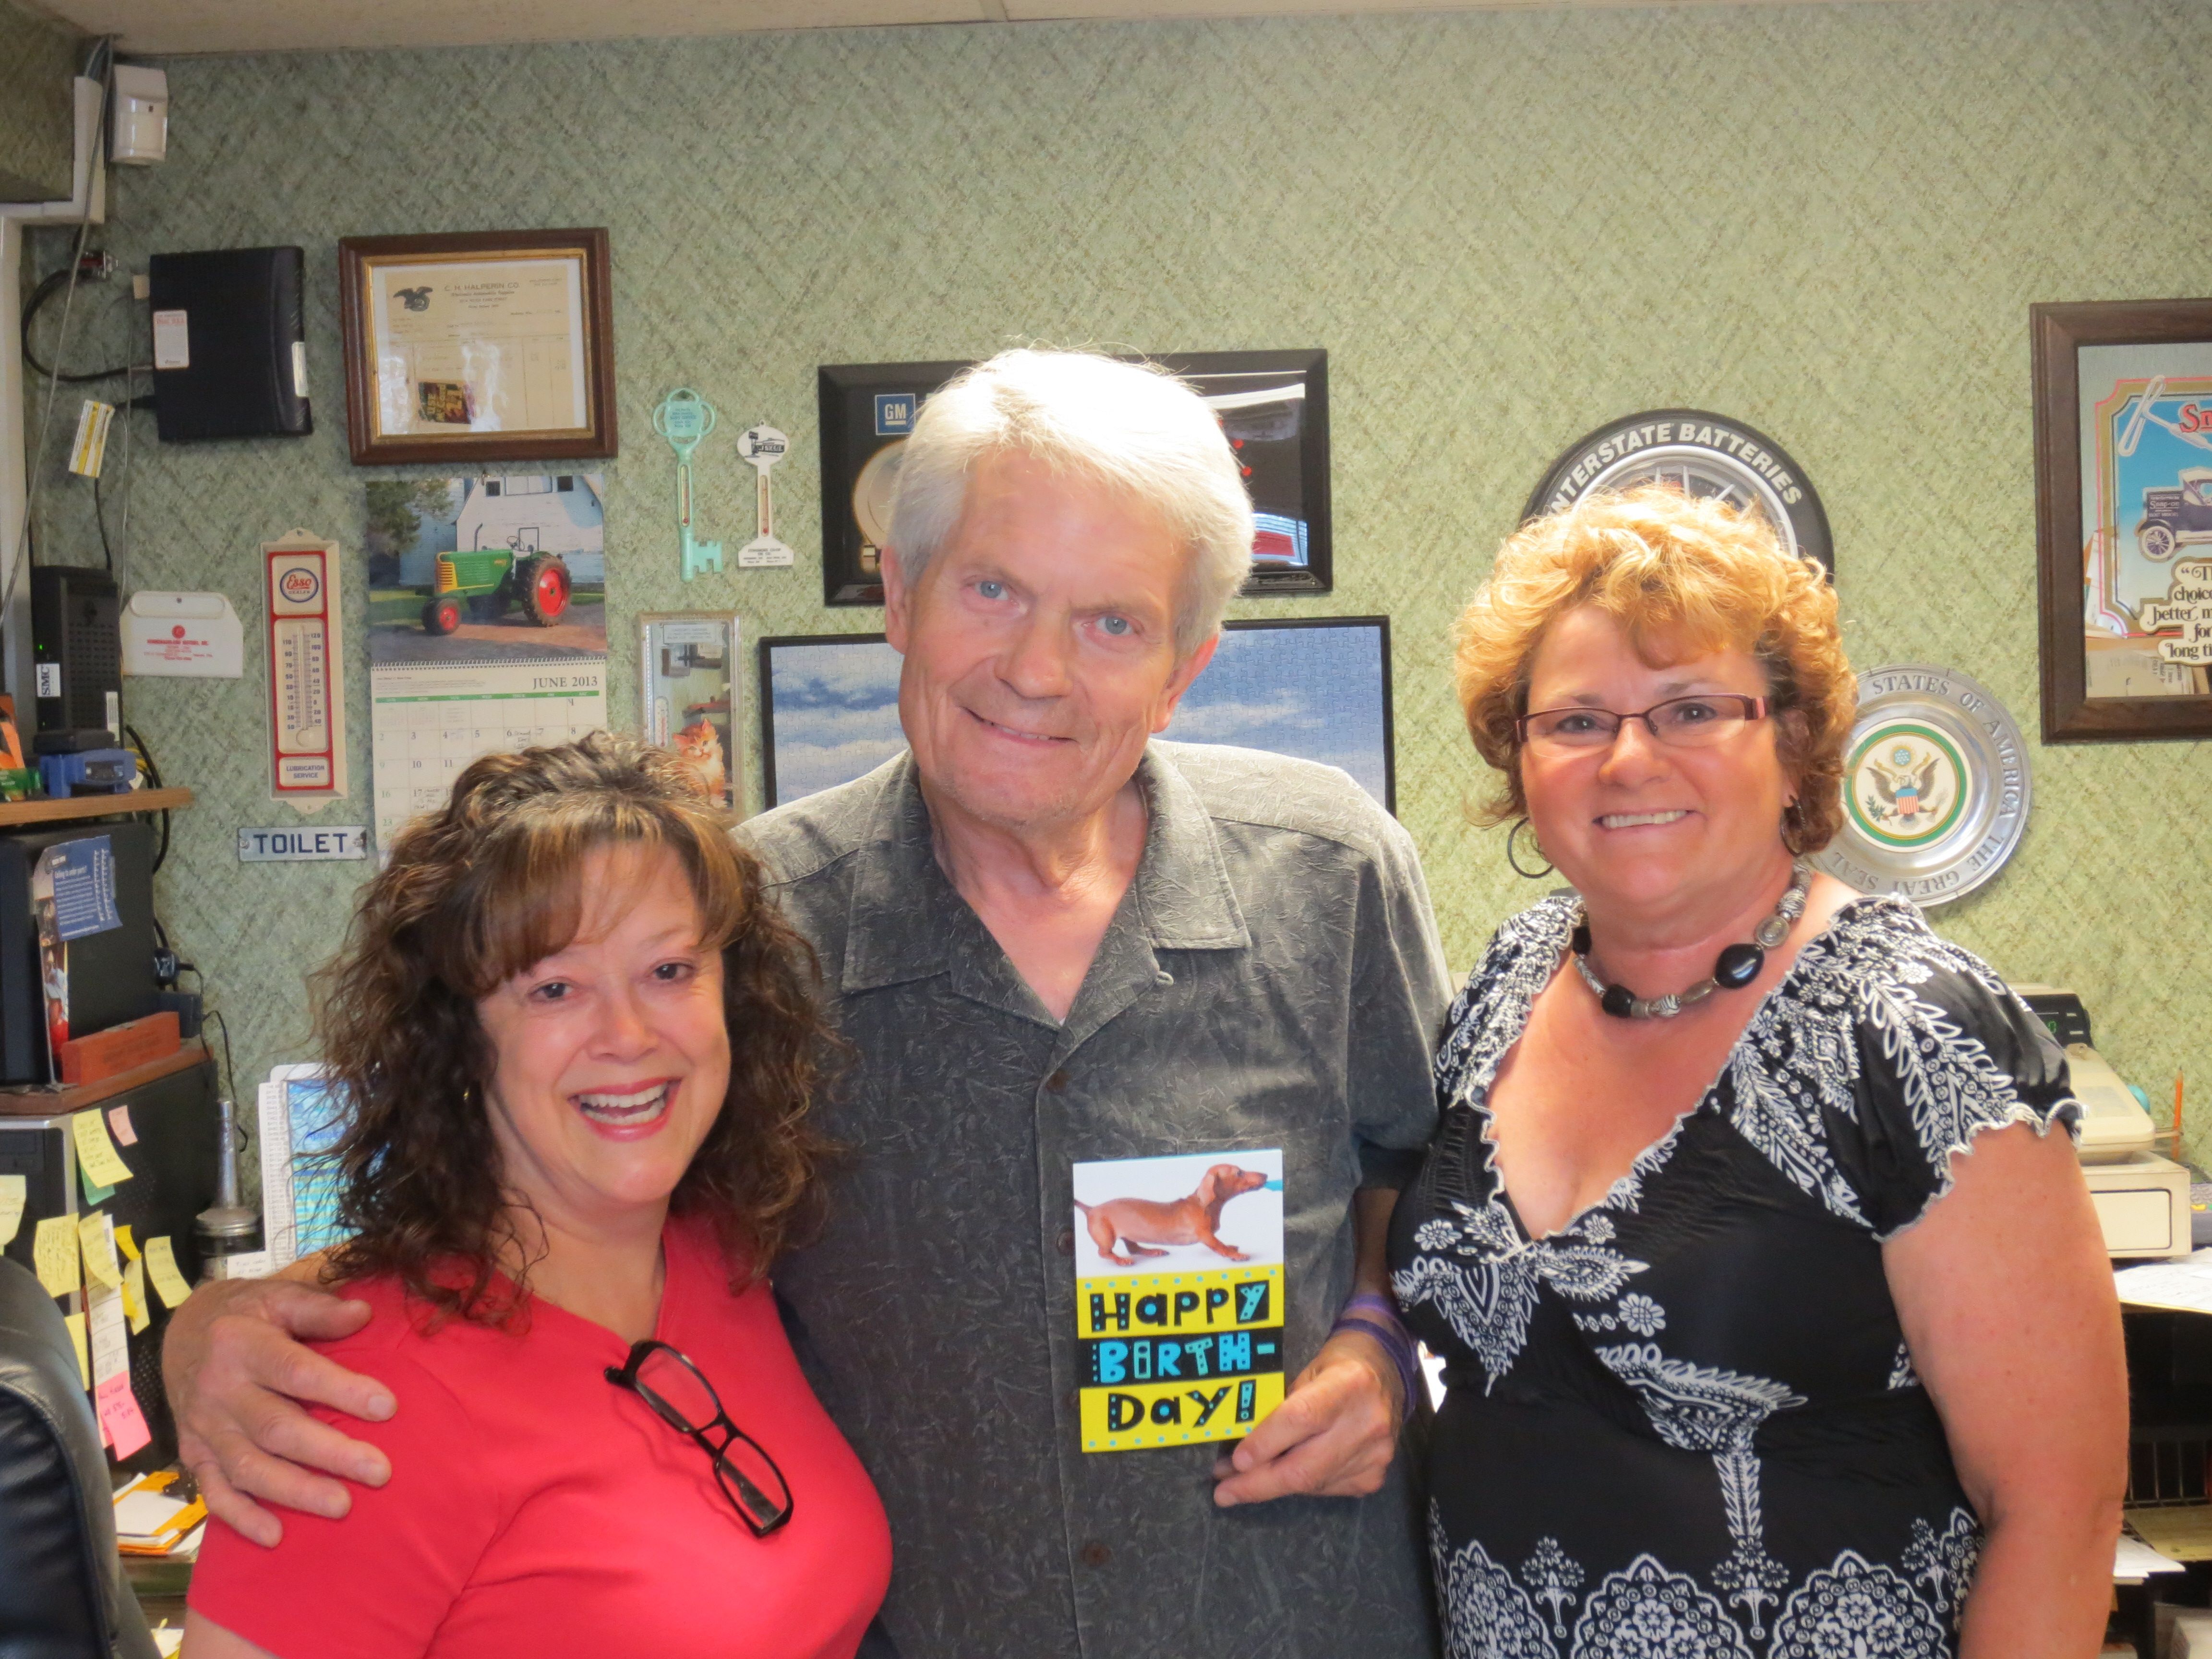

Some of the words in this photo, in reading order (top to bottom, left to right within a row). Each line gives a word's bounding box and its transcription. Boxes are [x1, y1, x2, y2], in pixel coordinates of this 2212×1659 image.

[885, 403, 907, 420] GM
[1679, 423, 1802, 505] BATTERIES
[2150, 501, 2179, 510] Snap-on
[287, 574, 312, 589] Esso
[2147, 606, 2199, 625] better
[2165, 643, 2200, 660] long
[41, 665, 50, 697] SMC
[532, 677, 567, 689] JUNE
[572, 676, 598, 687] 2013
[475, 730, 480, 738] 5
[1873, 674, 1950, 696] STATES
[1960, 693, 1984, 712] OF
[1984, 720, 2020, 818] AMERICA
[444, 759, 453, 768] 11
[253, 833, 349, 853] TOILET
[1967, 835, 2003, 872] THE
[1833, 851, 1879, 890] SEAL
[1089, 1279, 1270, 1333] Happy
[1092, 1331, 1275, 1383] BIRTH-
